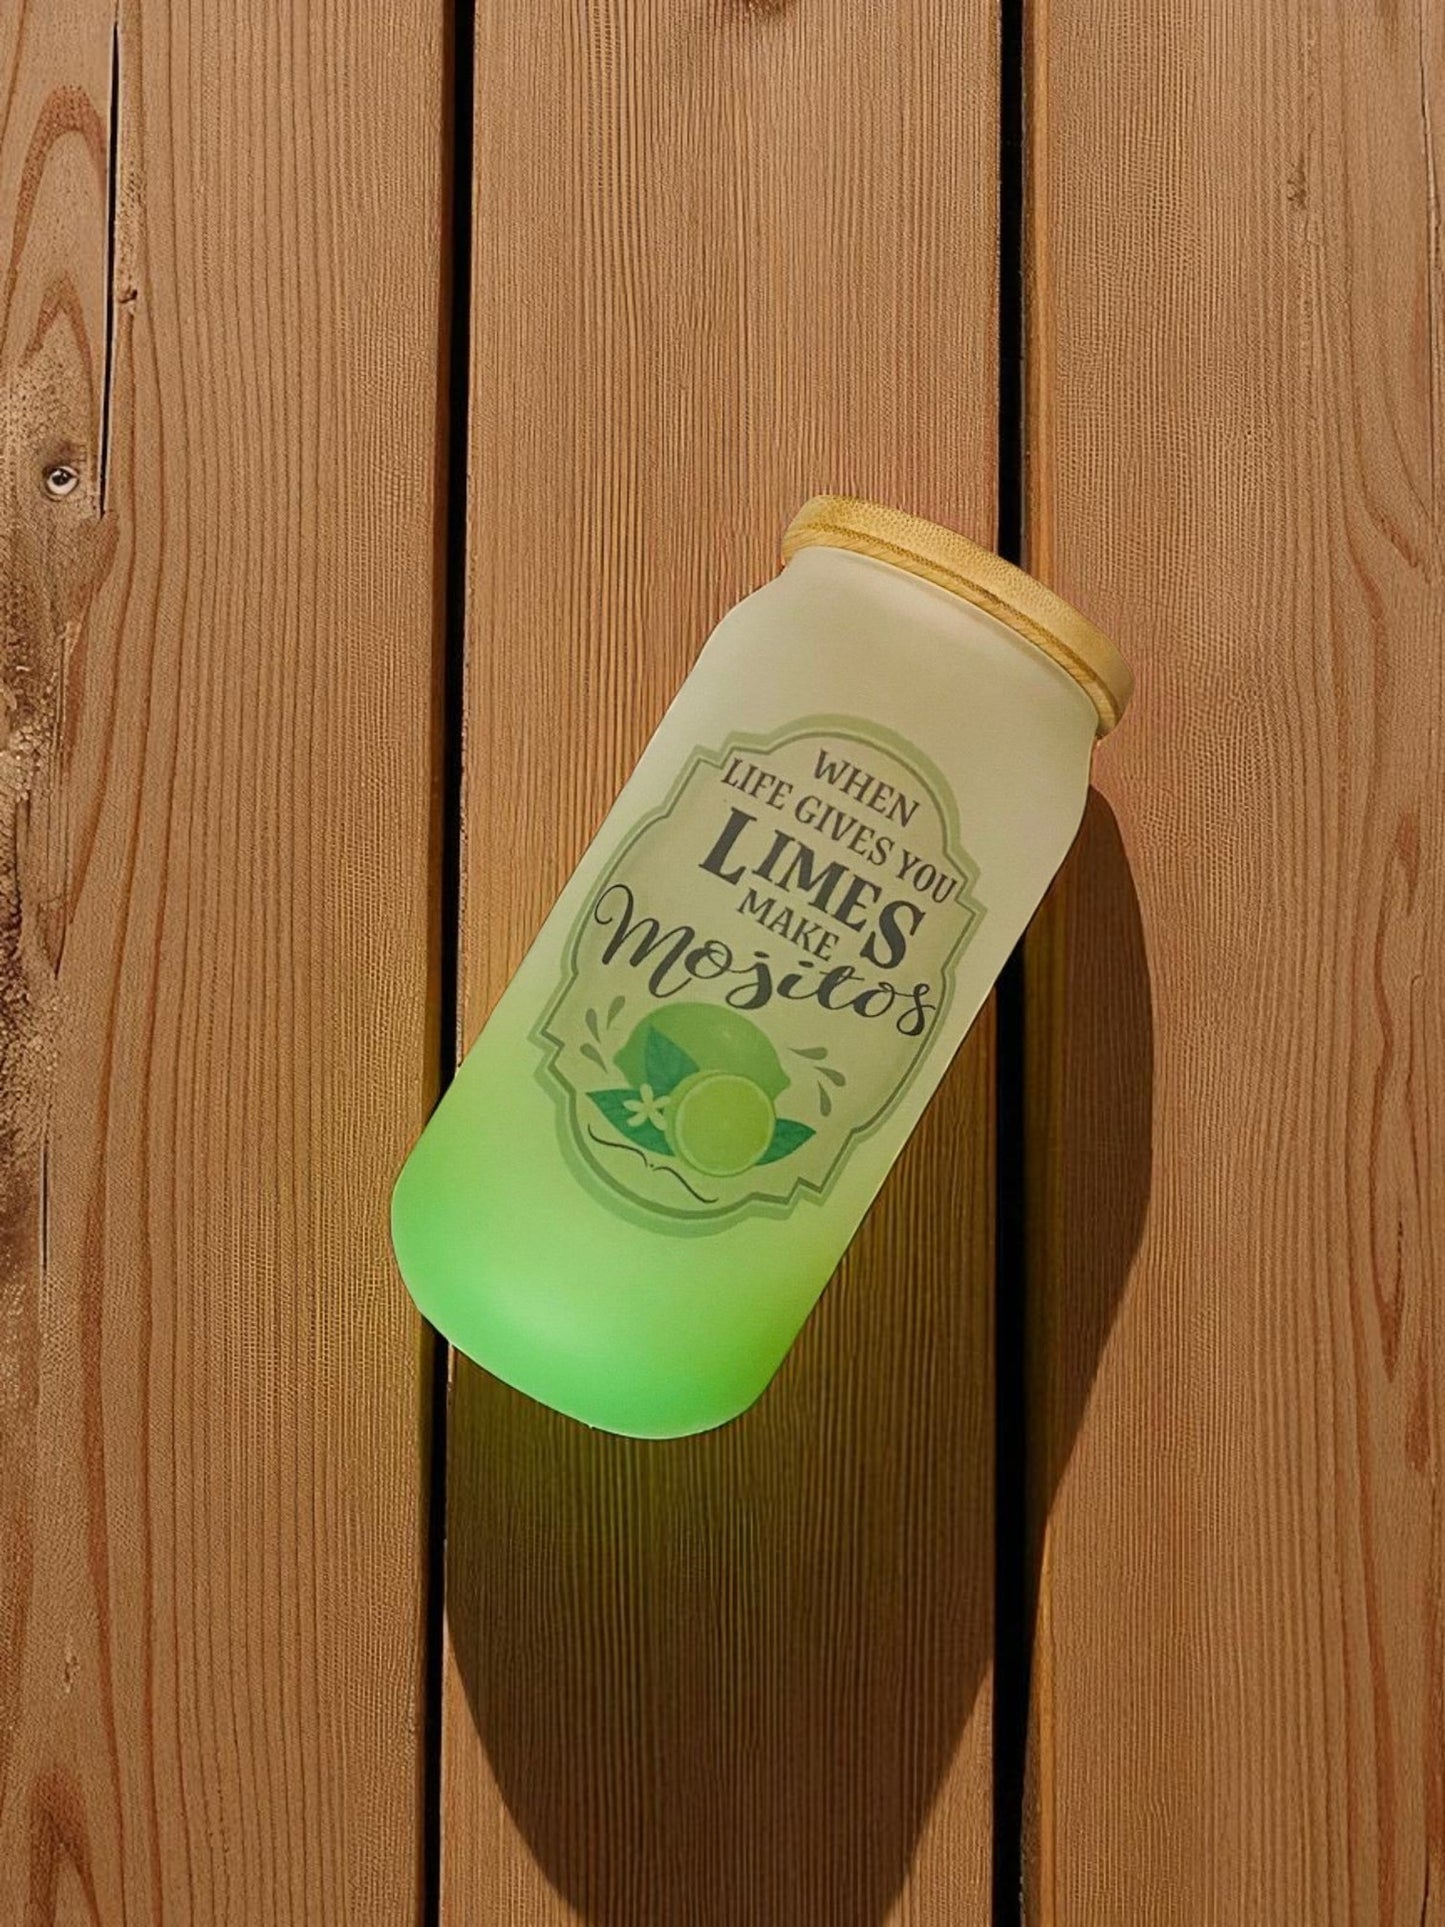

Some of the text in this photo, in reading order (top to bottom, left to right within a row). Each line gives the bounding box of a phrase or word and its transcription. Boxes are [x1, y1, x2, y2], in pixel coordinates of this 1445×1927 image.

[720, 757, 958, 904] LIFE GIVES YOU
[813, 747, 920, 828] WHEN
[698, 807, 926, 969] LIMES
[736, 887, 840, 961] MAKE
